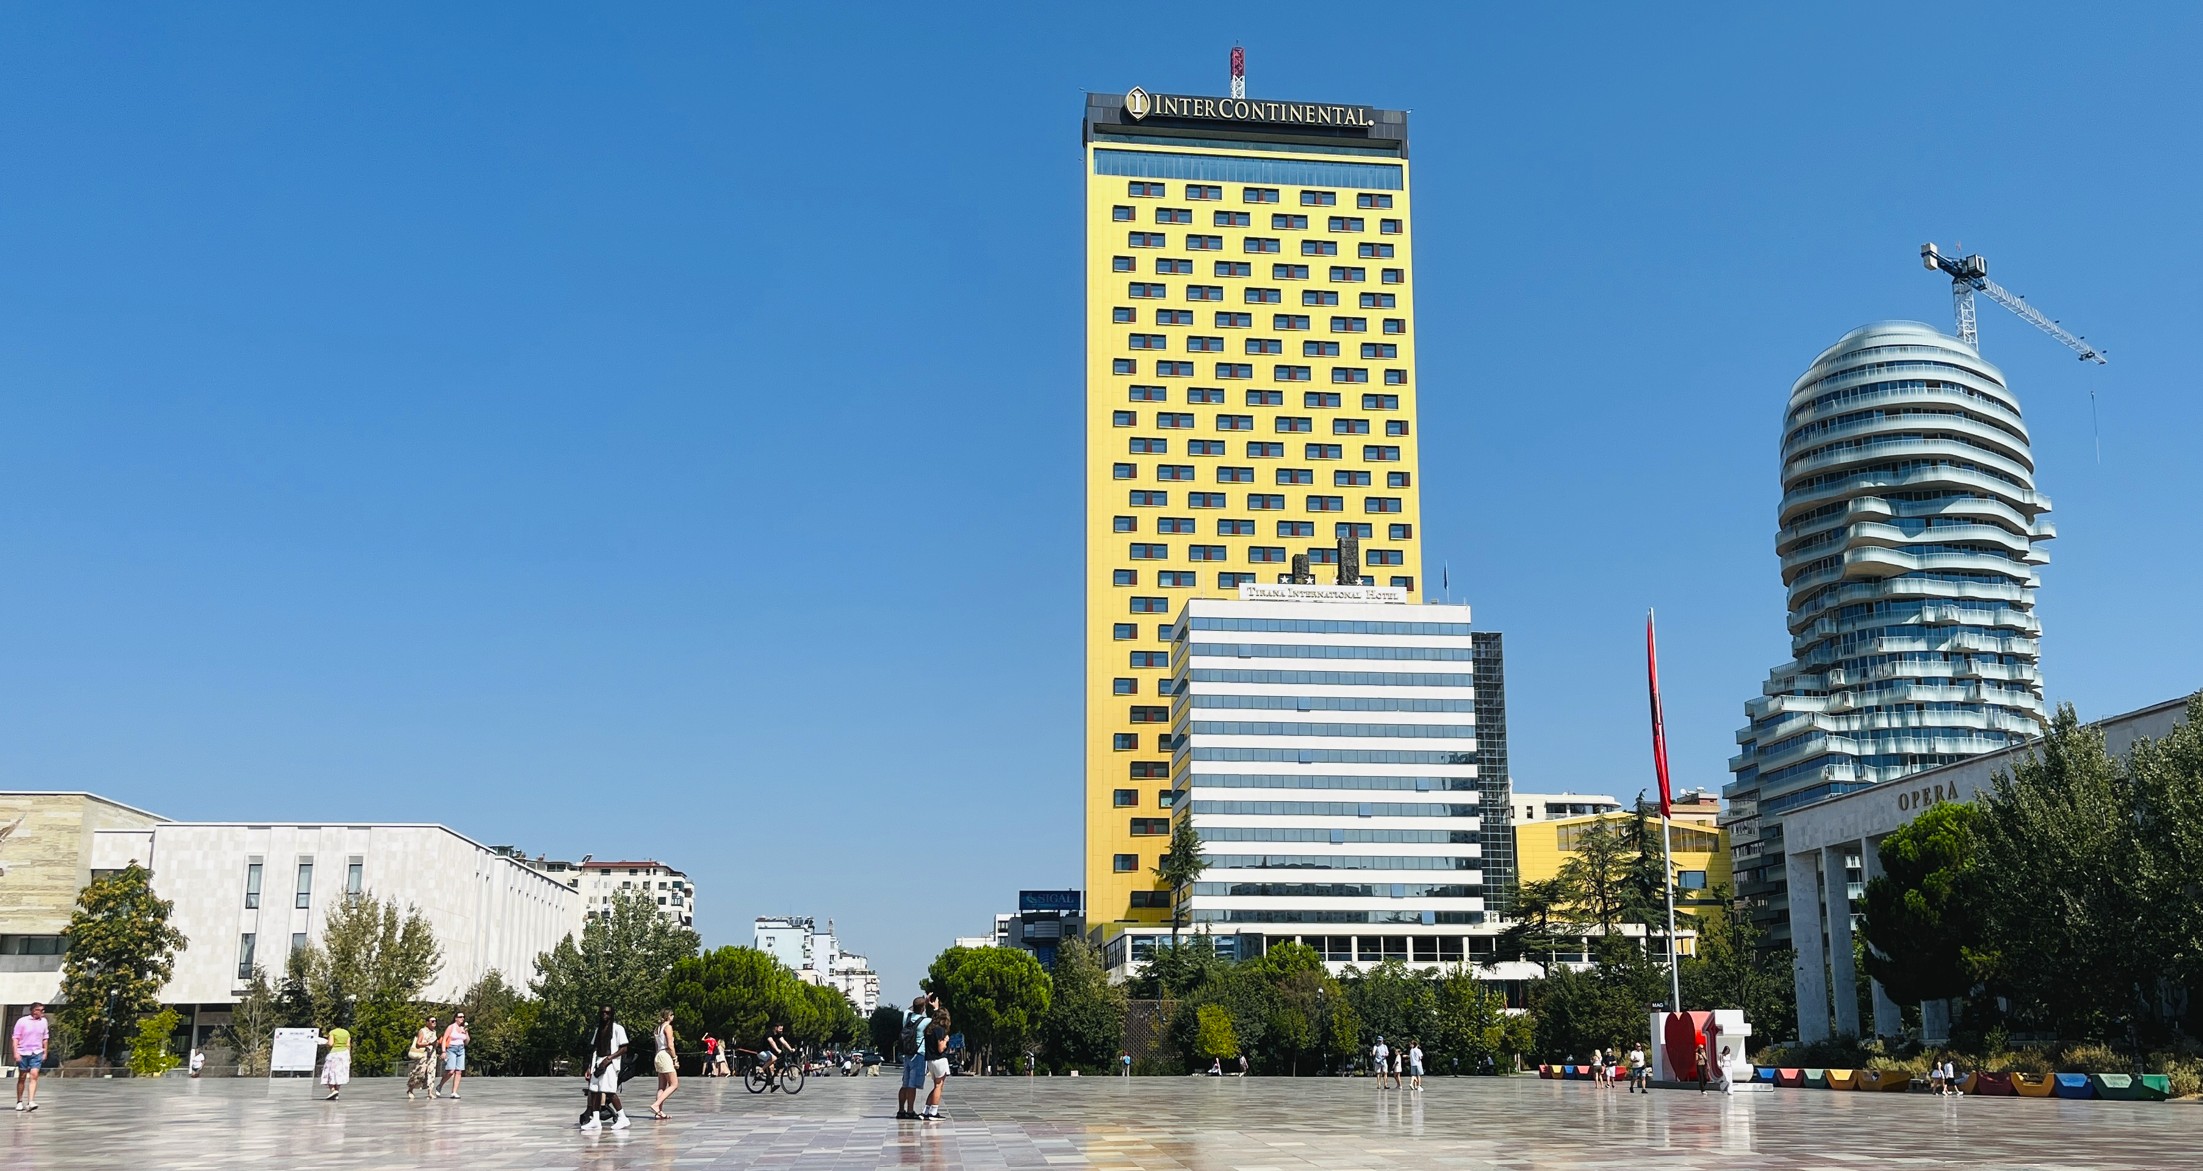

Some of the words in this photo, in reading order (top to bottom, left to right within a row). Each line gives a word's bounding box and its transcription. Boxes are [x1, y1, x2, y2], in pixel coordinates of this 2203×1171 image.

[1246, 586, 1286, 598] TIRANA
[1287, 588, 1361, 599] INTERNATIONAL
[1365, 590, 1399, 600] HOTEL
[1898, 780, 1959, 811] OPERA
[1038, 893, 1074, 904] SIGAL
